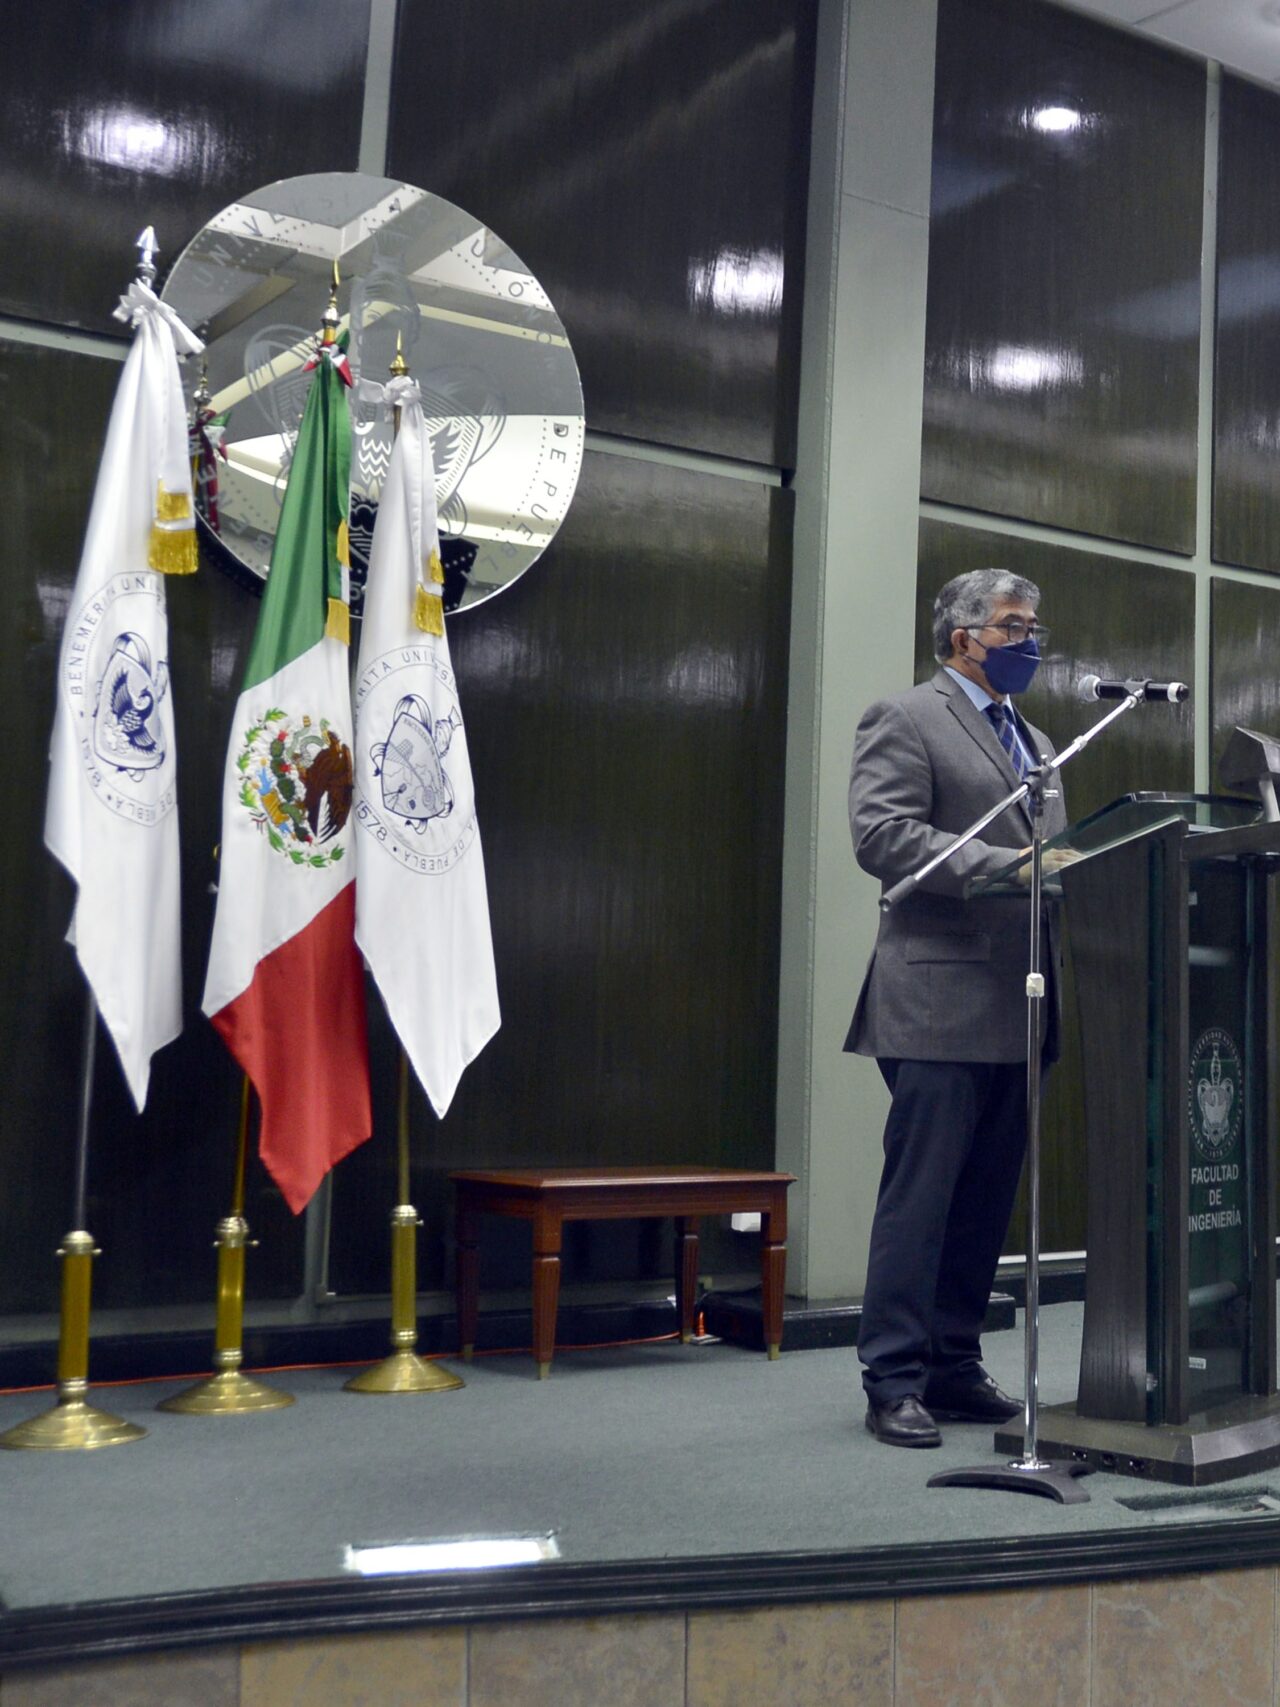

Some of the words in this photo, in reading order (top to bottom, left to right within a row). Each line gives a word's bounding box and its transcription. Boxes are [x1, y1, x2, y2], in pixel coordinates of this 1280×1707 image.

[550, 422, 569, 464] DE
[405, 851, 449, 871] PUEBLA
[1191, 1164, 1239, 1185] FACULTAD
[1209, 1188, 1222, 1206] DE
[1188, 1204, 1241, 1232] INGENIERÍA
